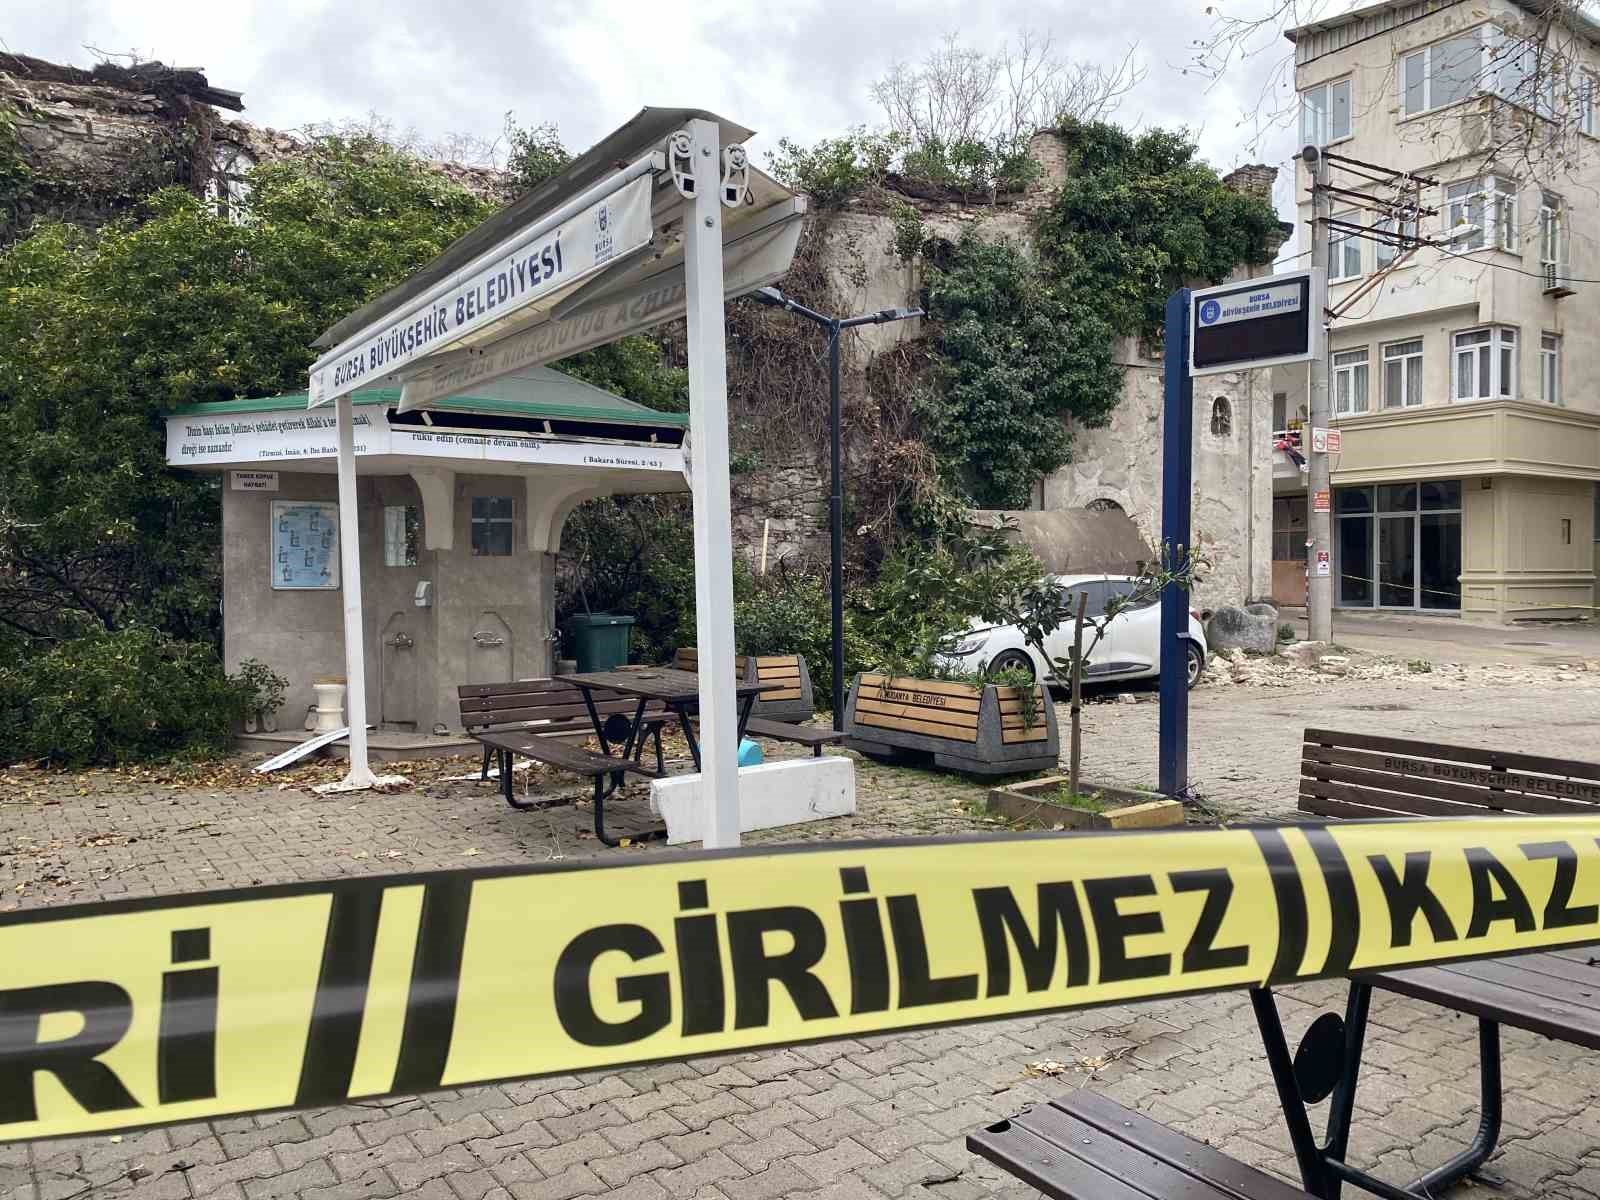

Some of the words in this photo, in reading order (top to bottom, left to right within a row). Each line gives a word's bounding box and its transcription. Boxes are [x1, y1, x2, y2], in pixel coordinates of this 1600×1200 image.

[1249, 293, 1270, 303] BURSA
[1261, 295, 1299, 311] BELEDİYESİ
[334, 353, 365, 387] BURSA
[370, 303, 448, 370] BÜYÜKŞEHİR
[455, 230, 562, 326] BELEDİYESİ
[493, 437, 518, 447] devam
[1384, 758, 1425, 773] BURSA
[553, 866, 1250, 1047] GİRİLMEZ
[1367, 838, 1600, 948] KAZ
